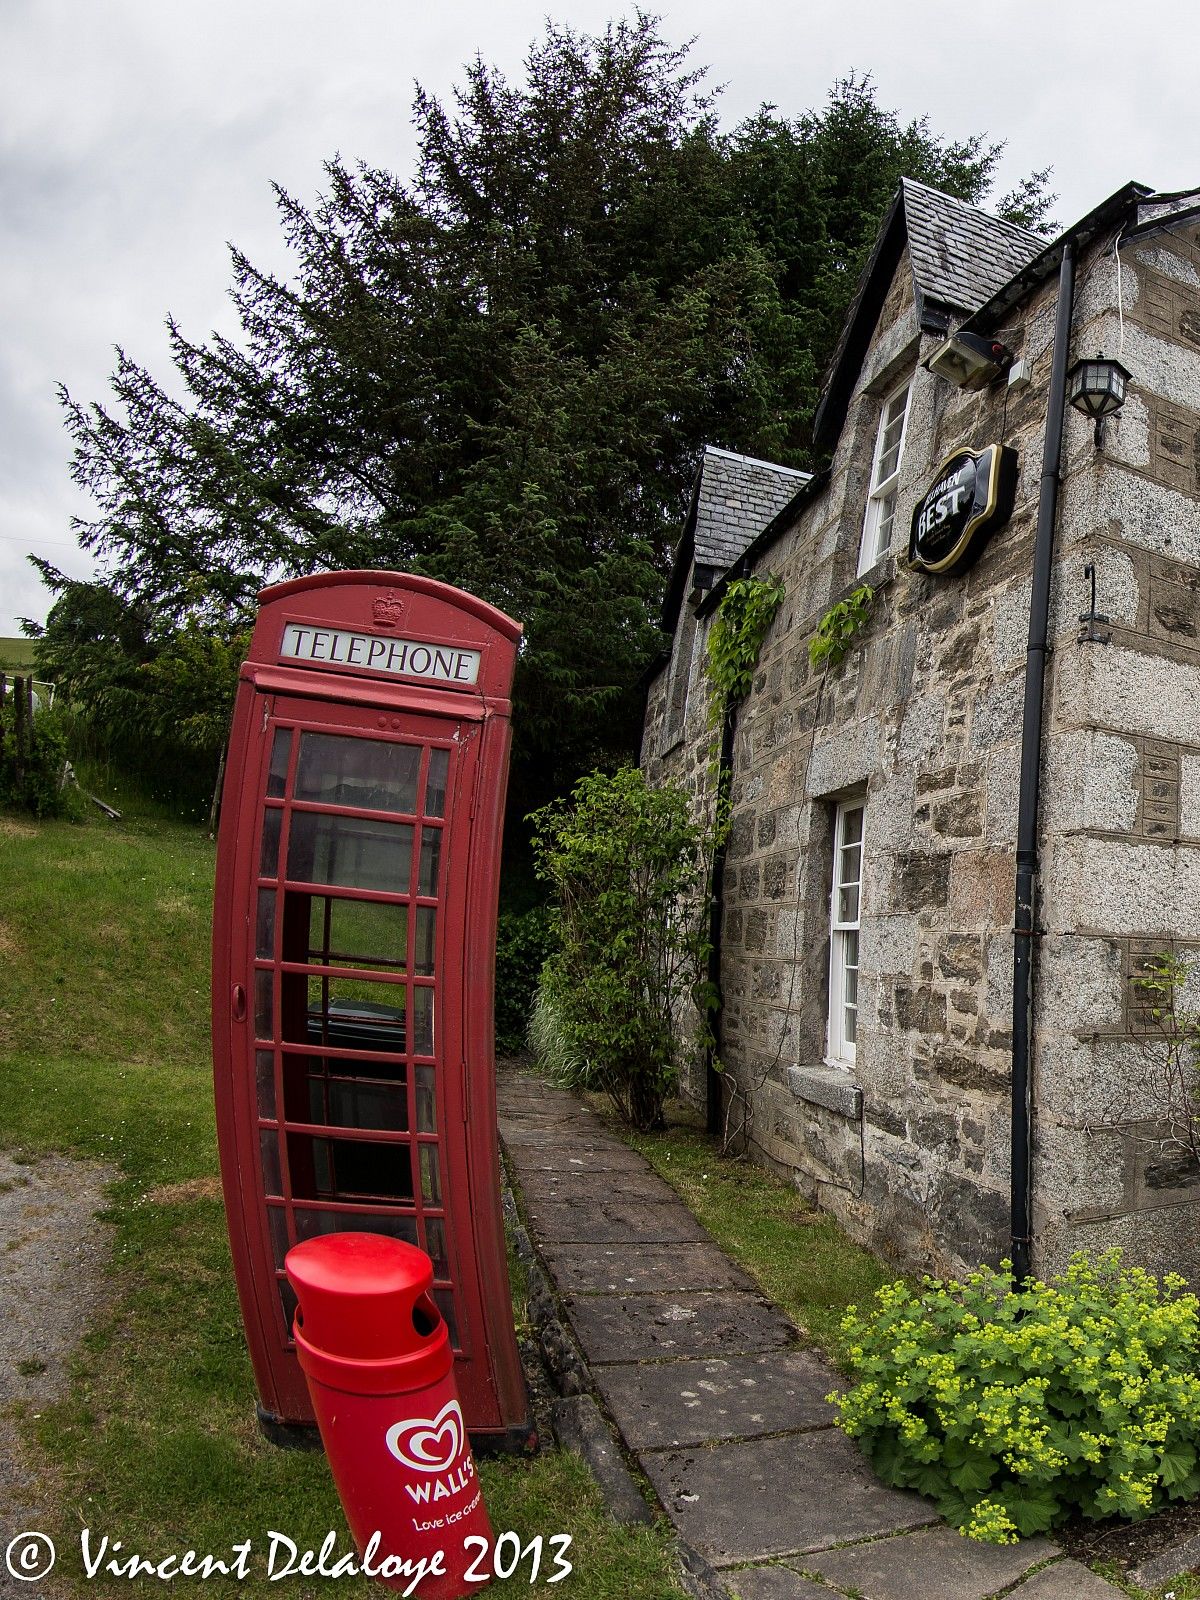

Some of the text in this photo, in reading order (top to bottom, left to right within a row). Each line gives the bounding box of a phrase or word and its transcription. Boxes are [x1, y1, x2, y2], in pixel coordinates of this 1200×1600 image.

[918, 485, 965, 541] BEST
[292, 629, 473, 680] TELEPHONE
[404, 1455, 474, 1504] WALL'S
[412, 1517, 445, 1531] Love
[445, 1511, 462, 1524] ice
